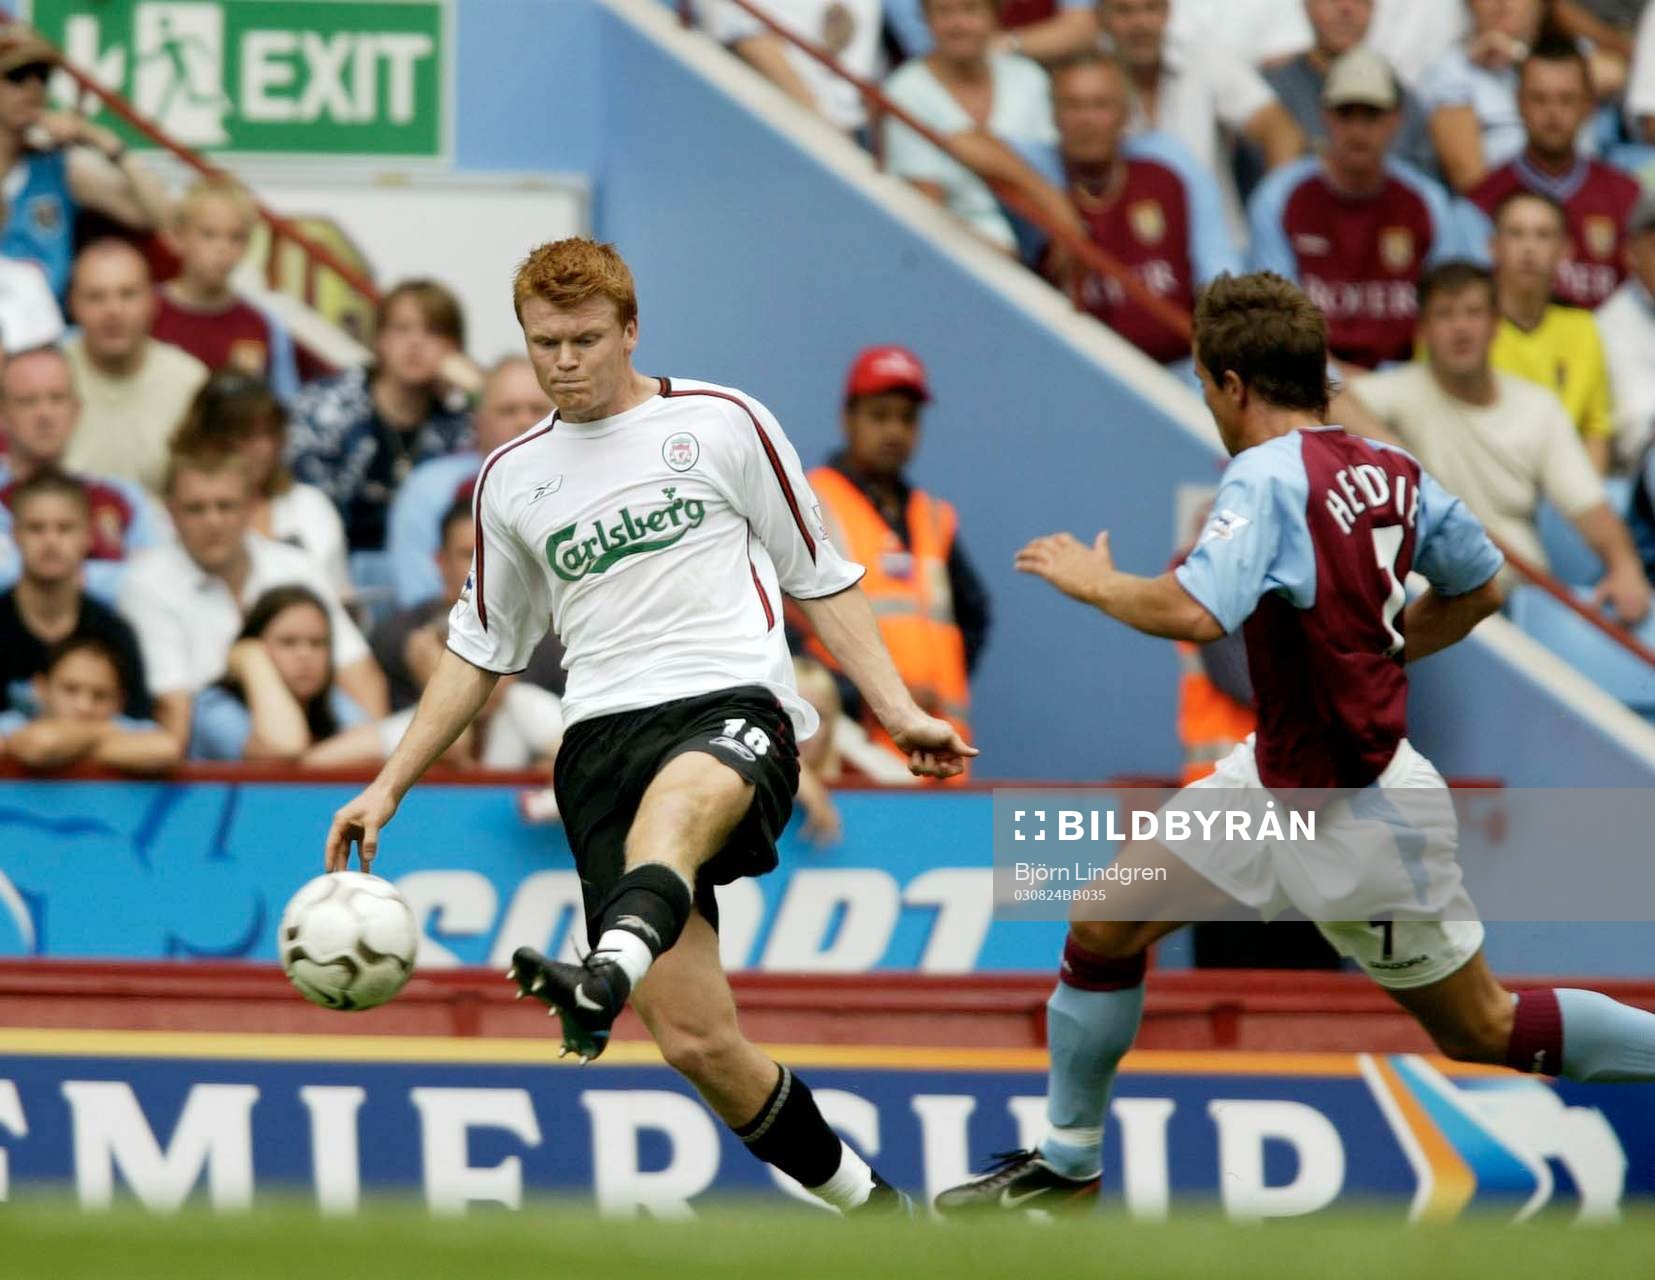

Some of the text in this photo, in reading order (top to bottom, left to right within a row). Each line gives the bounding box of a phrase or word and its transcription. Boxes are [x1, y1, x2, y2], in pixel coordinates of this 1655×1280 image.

[240, 29, 433, 124] EXIT
[546, 494, 706, 581] Carlsberg
[722, 718, 770, 755] 18
